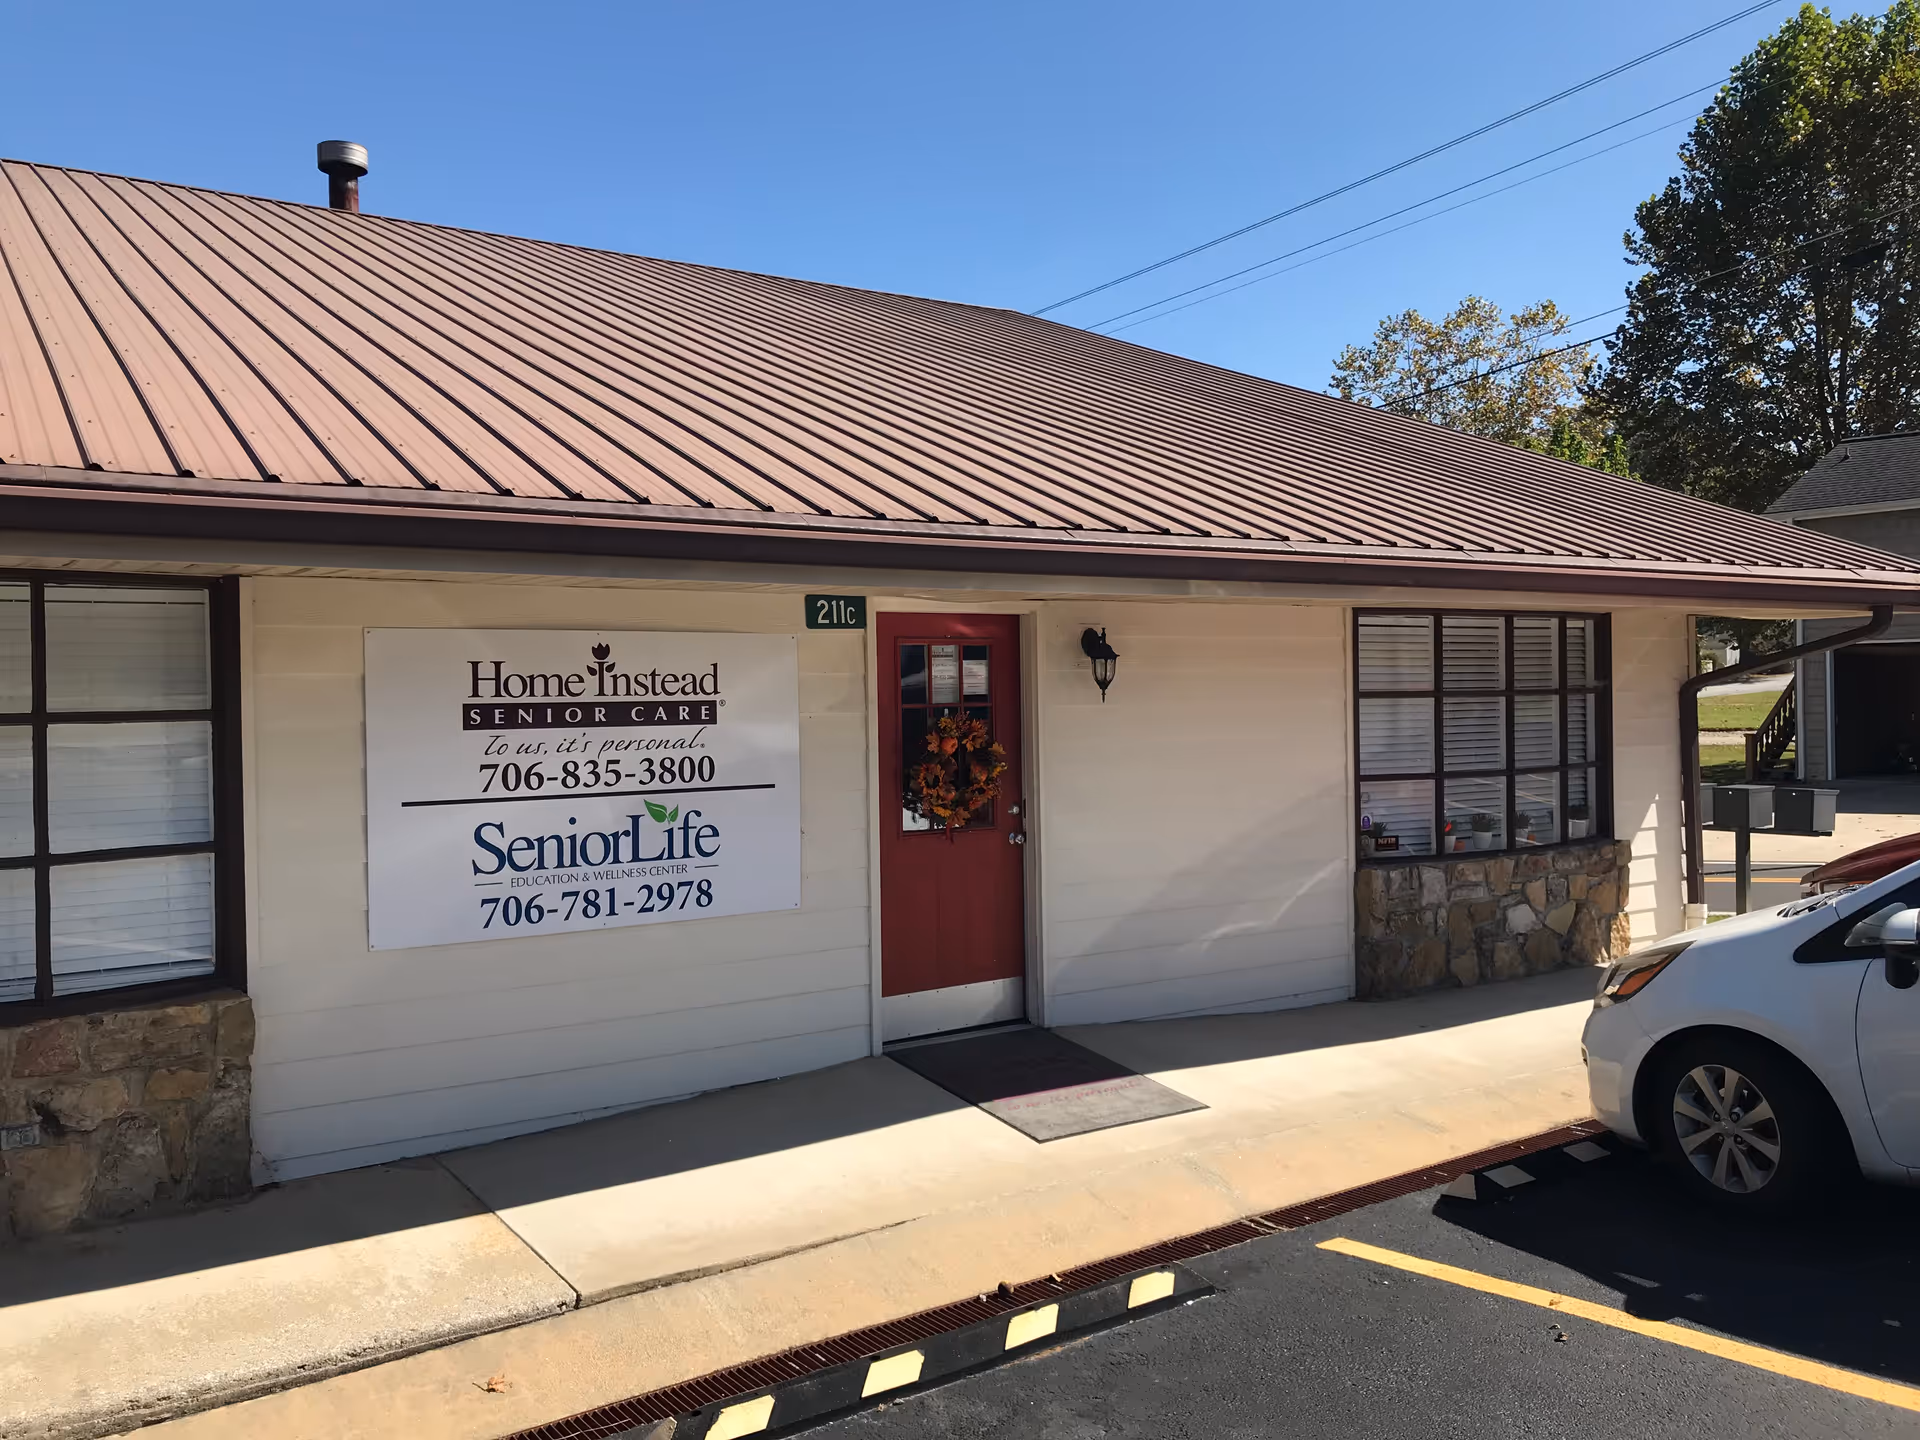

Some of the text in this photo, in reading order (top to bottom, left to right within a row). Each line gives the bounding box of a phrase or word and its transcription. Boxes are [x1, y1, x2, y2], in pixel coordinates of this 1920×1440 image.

[466, 660, 721, 698] Home Instead
[469, 705, 710, 725] SENIOR CARE
[484, 735, 508, 756] To
[516, 742, 548, 756] us,
[556, 732, 592, 753] it's
[478, 755, 716, 793] 706-835-3800
[471, 809, 721, 876] SeniorLife
[510, 864, 688, 888] EDUCATION & WELLNESS CENTER
[480, 878, 714, 930] 706-781-2978
